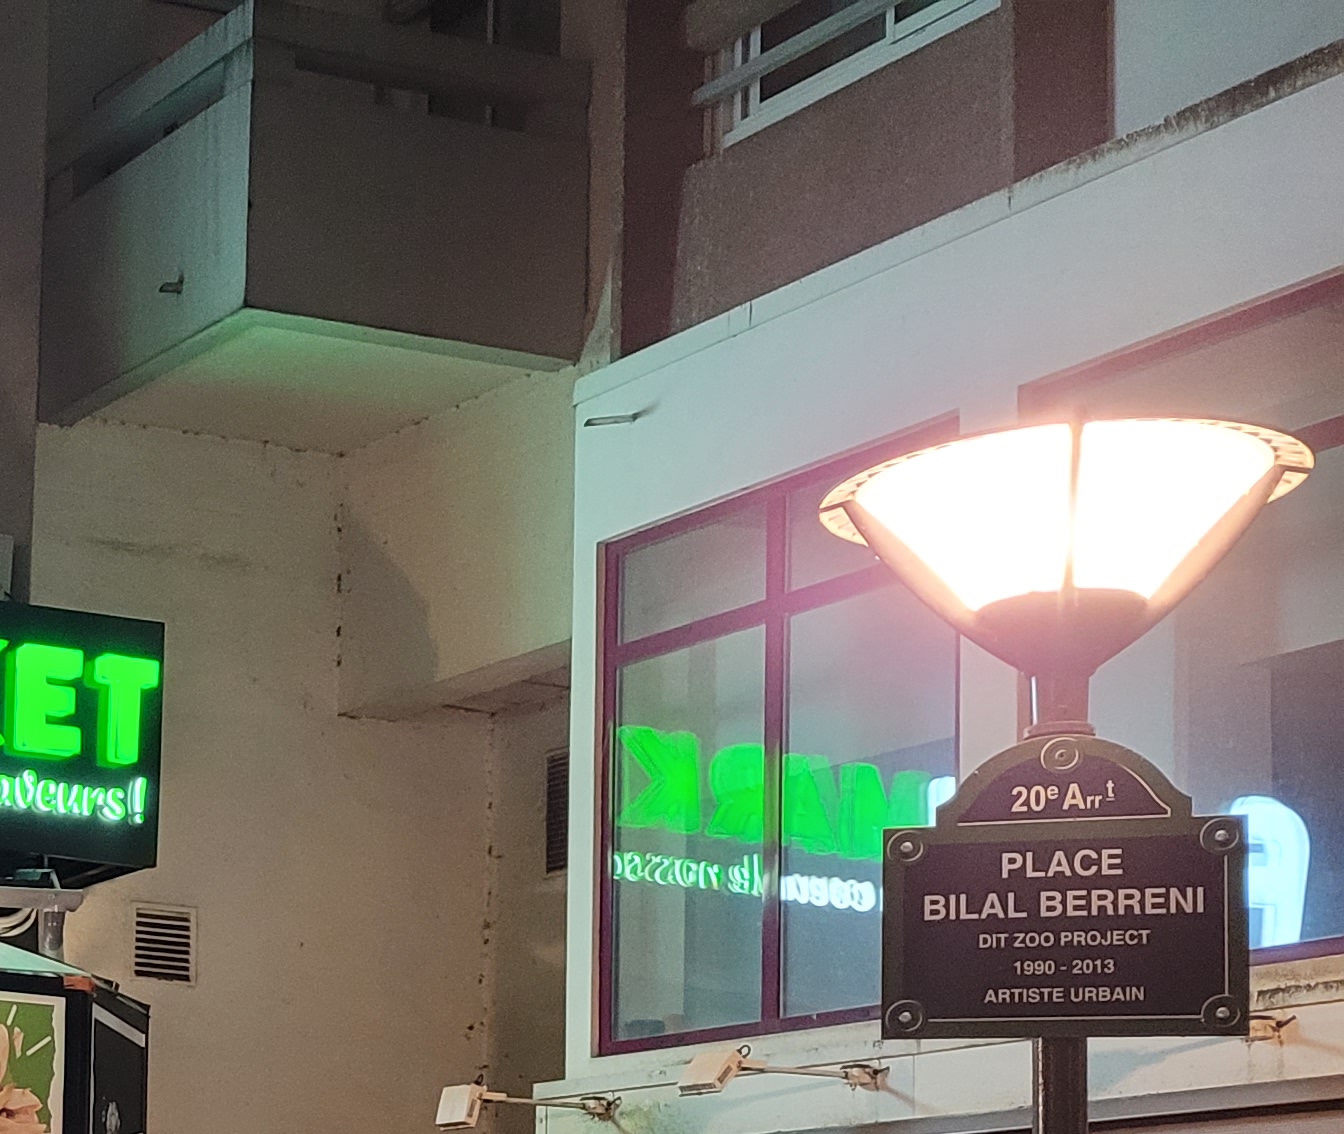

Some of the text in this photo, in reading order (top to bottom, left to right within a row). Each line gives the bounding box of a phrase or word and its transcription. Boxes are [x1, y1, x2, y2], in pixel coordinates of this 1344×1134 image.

[1000, 848, 1124, 878] PLACE
[923, 886, 1205, 921] BILAL BERRENI
[978, 929, 1151, 949] DIT ZOO PROJECT
[1013, 960, 1055, 975] 1990
[1072, 959, 1115, 974] 2013
[984, 986, 1144, 1004] ARTISTE URBAIN
